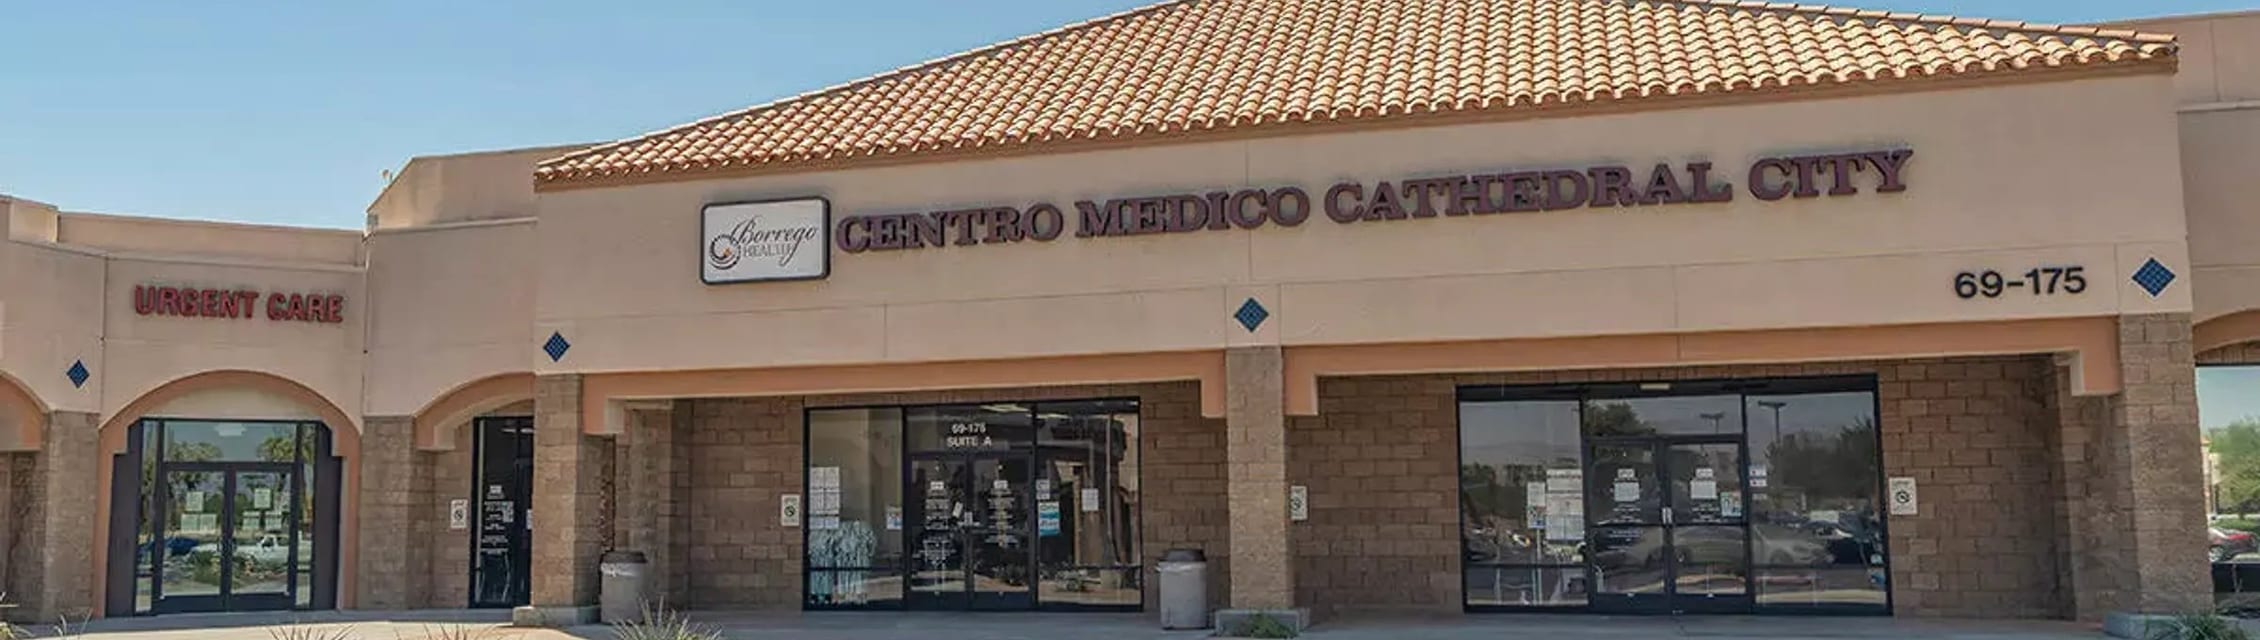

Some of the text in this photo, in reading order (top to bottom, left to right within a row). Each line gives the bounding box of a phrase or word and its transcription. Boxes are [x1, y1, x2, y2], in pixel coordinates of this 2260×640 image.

[836, 149, 1914, 254] CENTRO MEDICO CATHEDRAL CITY
[731, 215, 818, 266] Borrego
[1954, 266, 2087, 300] 69-175
[134, 284, 344, 323] URGENT CARE
[946, 436, 993, 448] SUITE A
